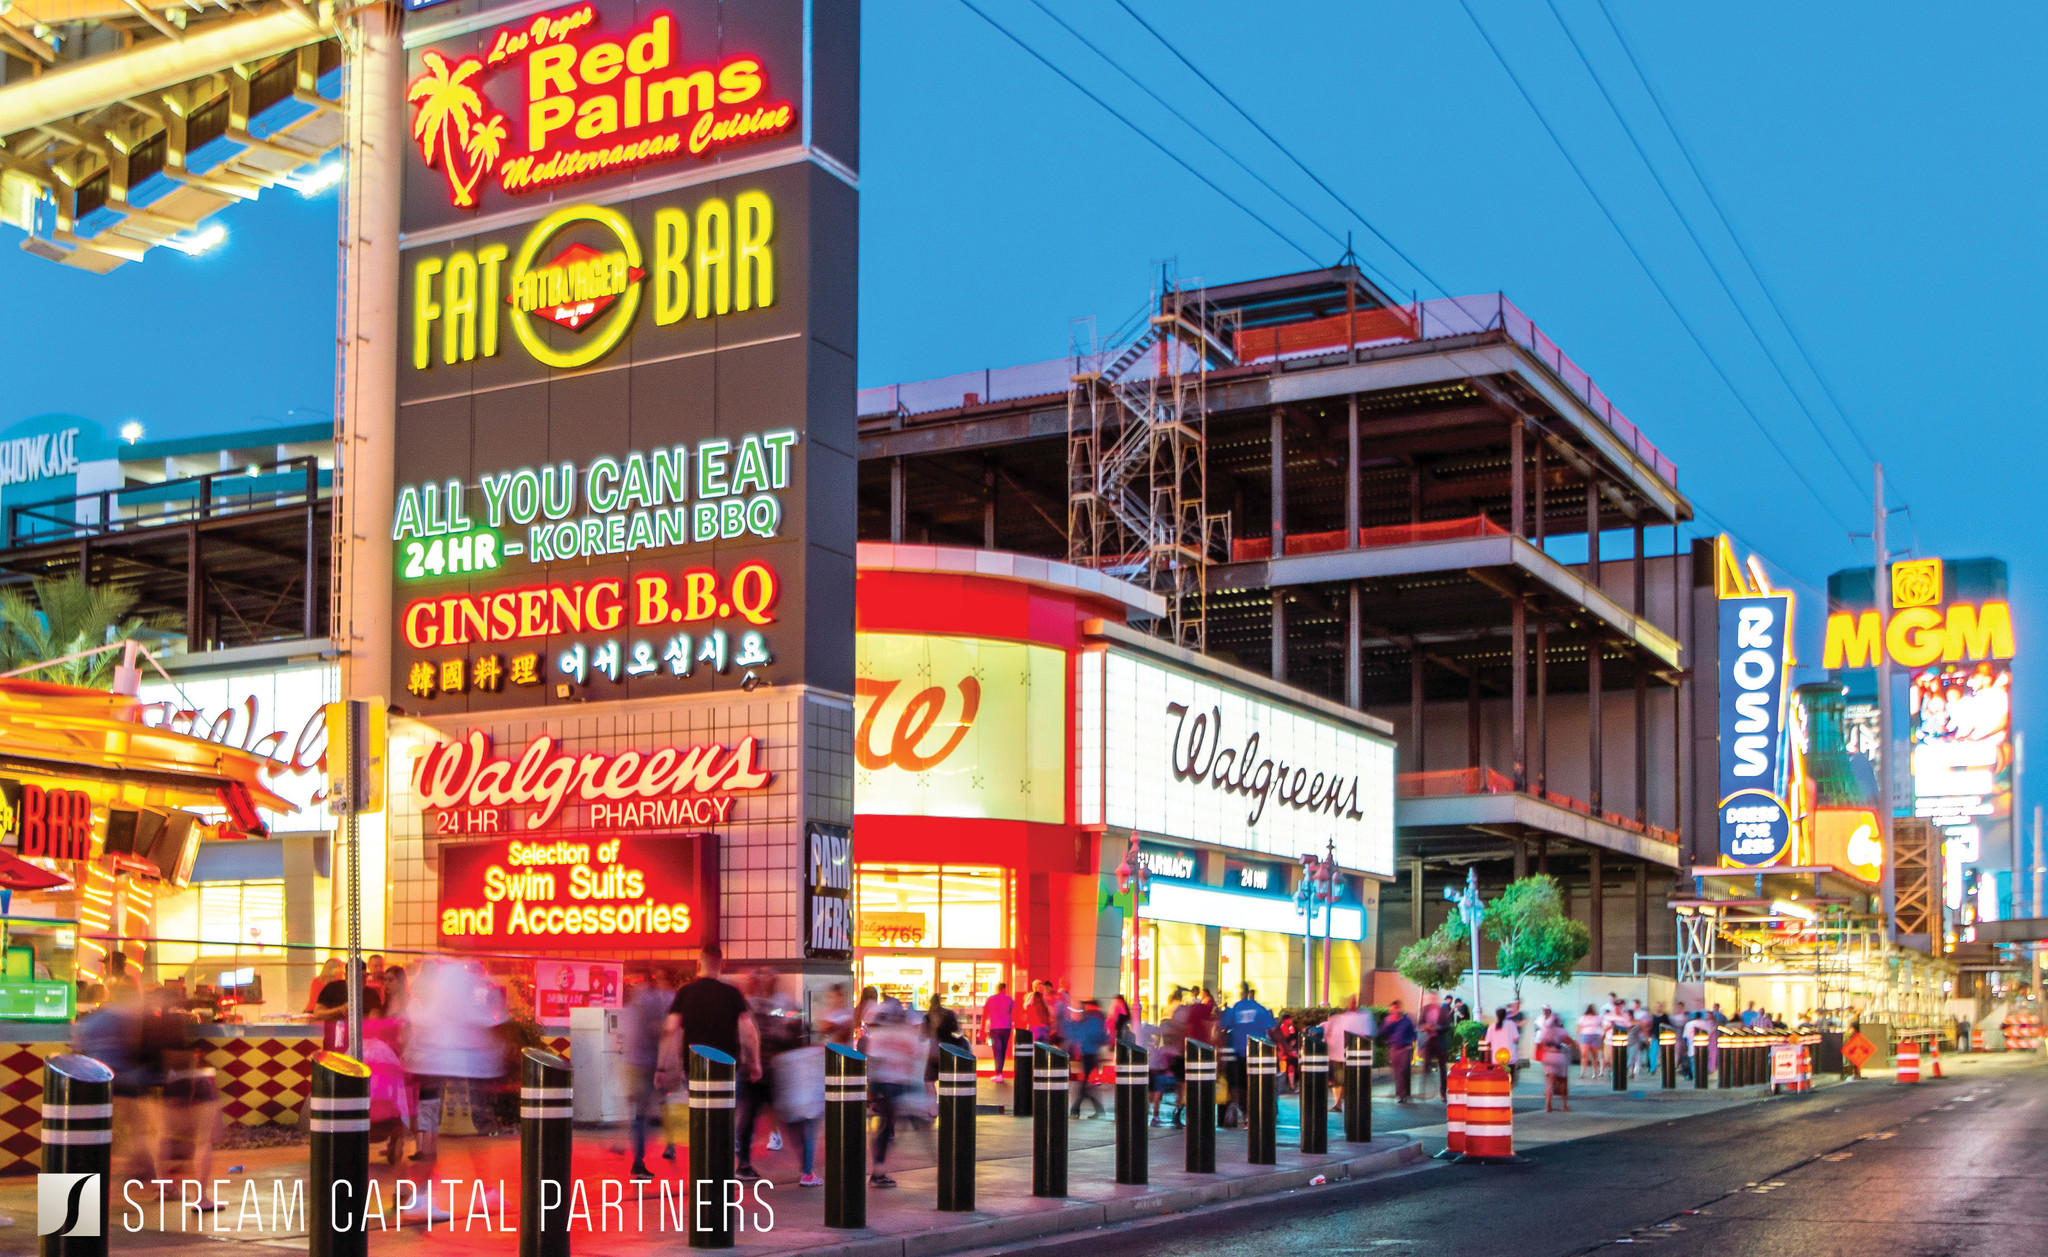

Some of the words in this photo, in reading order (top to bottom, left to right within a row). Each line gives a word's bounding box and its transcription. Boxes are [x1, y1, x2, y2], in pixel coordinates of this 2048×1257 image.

[487, 28, 531, 65] Las
[530, 6, 593, 47] Vegas
[529, 15, 670, 101] Red
[528, 59, 762, 152] Palms
[500, 132, 682, 190] Mediterranean
[688, 106, 791, 154] Cuisine
[414, 244, 508, 370] FAT
[654, 190, 774, 327] BAR
[513, 252, 627, 312] FATBURGER
[393, 479, 471, 541] ALL
[481, 464, 575, 529] YOU
[587, 446, 686, 513] CAN
[698, 429, 796, 500] EAT
[404, 533, 498, 579] 24HR
[530, 506, 686, 563] KOREAN
[694, 494, 781, 543] BBQ
[405, 580, 621, 649] GINSENG
[635, 564, 775, 626] B.B.Q
[1823, 600, 2016, 670] MGM
[407, 651, 539, 698] 韓國料理
[1732, 606, 1776, 778] ROSS
[407, 729, 772, 831] Walgreens
[1166, 700, 1364, 827] Walgreens
[23, 784, 92, 860] BAR
[437, 811, 460, 835] 24
[467, 808, 498, 832] HR
[590, 796, 732, 830] PHARMACY
[484, 866, 556, 902] Swim
[570, 865, 646, 900] Suits
[507, 841, 590, 866] Selection
[597, 839, 620, 864] of
[810, 833, 850, 889] PARK
[442, 904, 494, 936] and
[508, 902, 692, 936] Accessories
[811, 895, 850, 950] HERE
[877, 927, 922, 943] 3765
